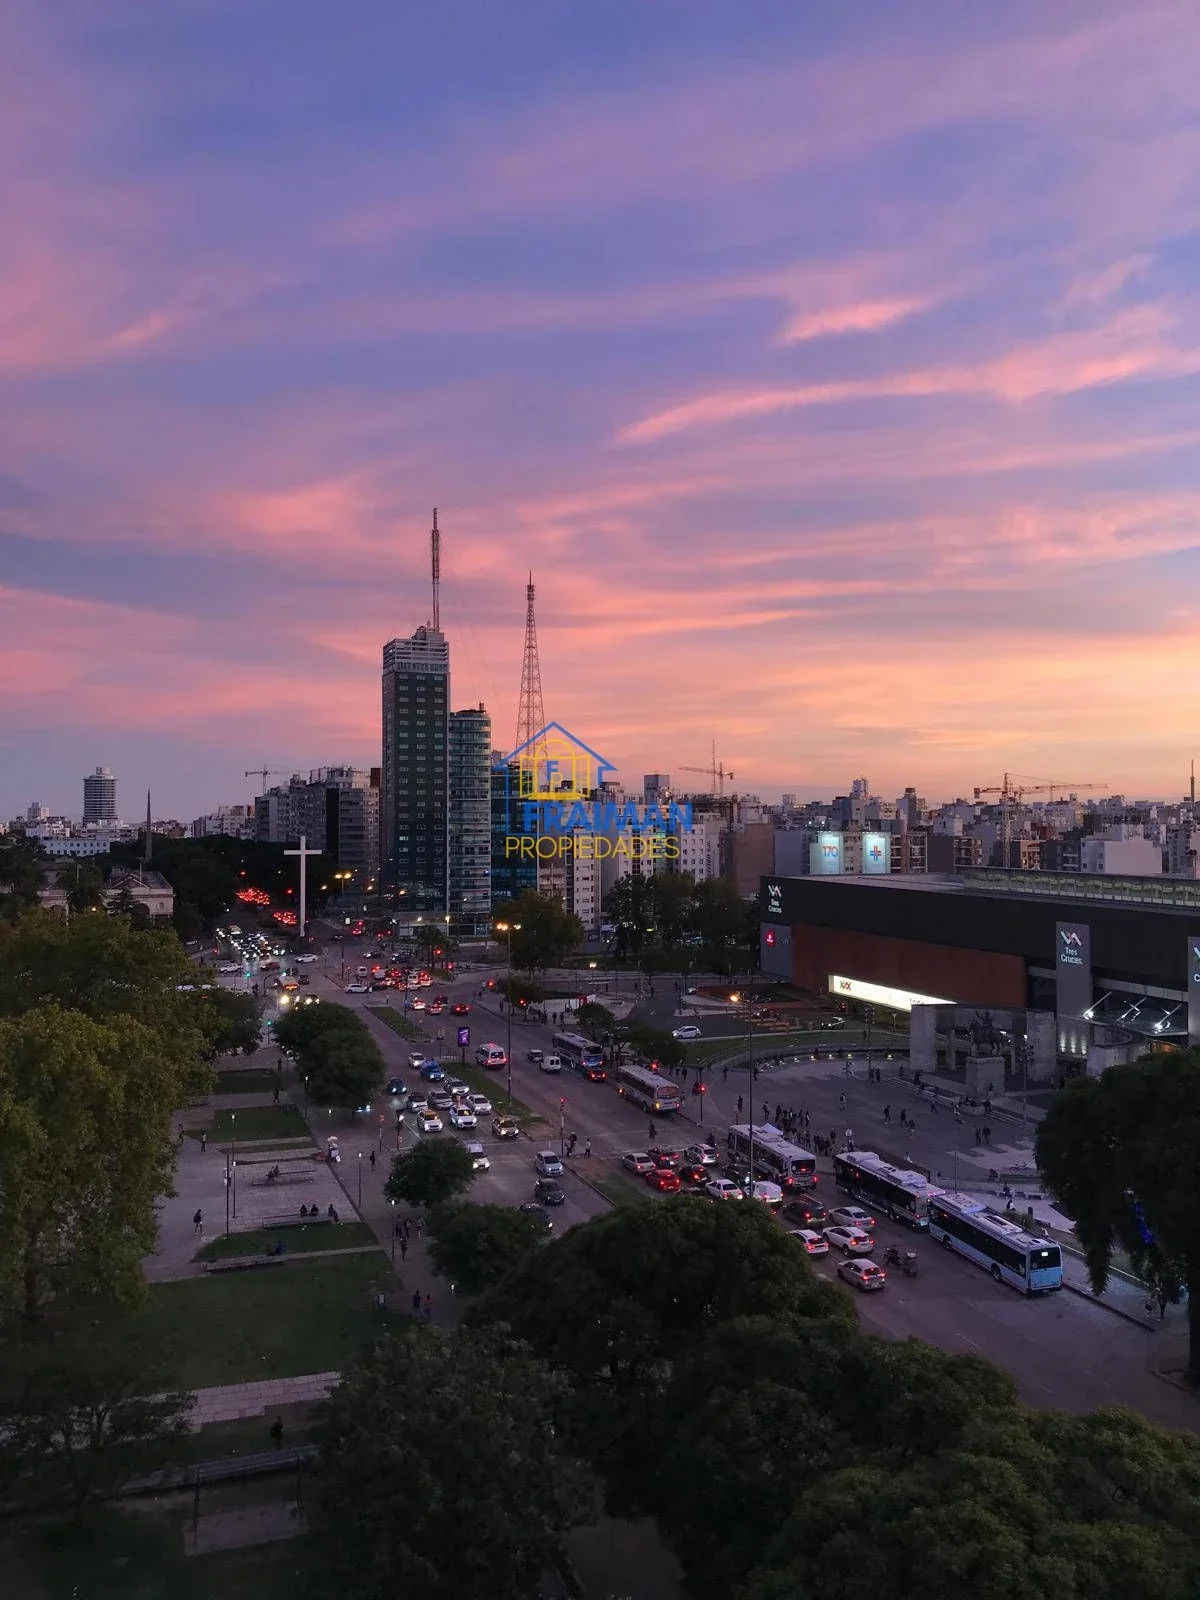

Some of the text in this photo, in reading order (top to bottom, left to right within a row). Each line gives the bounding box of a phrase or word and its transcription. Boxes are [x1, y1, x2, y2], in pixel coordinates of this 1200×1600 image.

[823, 846, 838, 857] 170
[1065, 947, 1078, 956] Tres
[1061, 954, 1083, 964] Cruces
